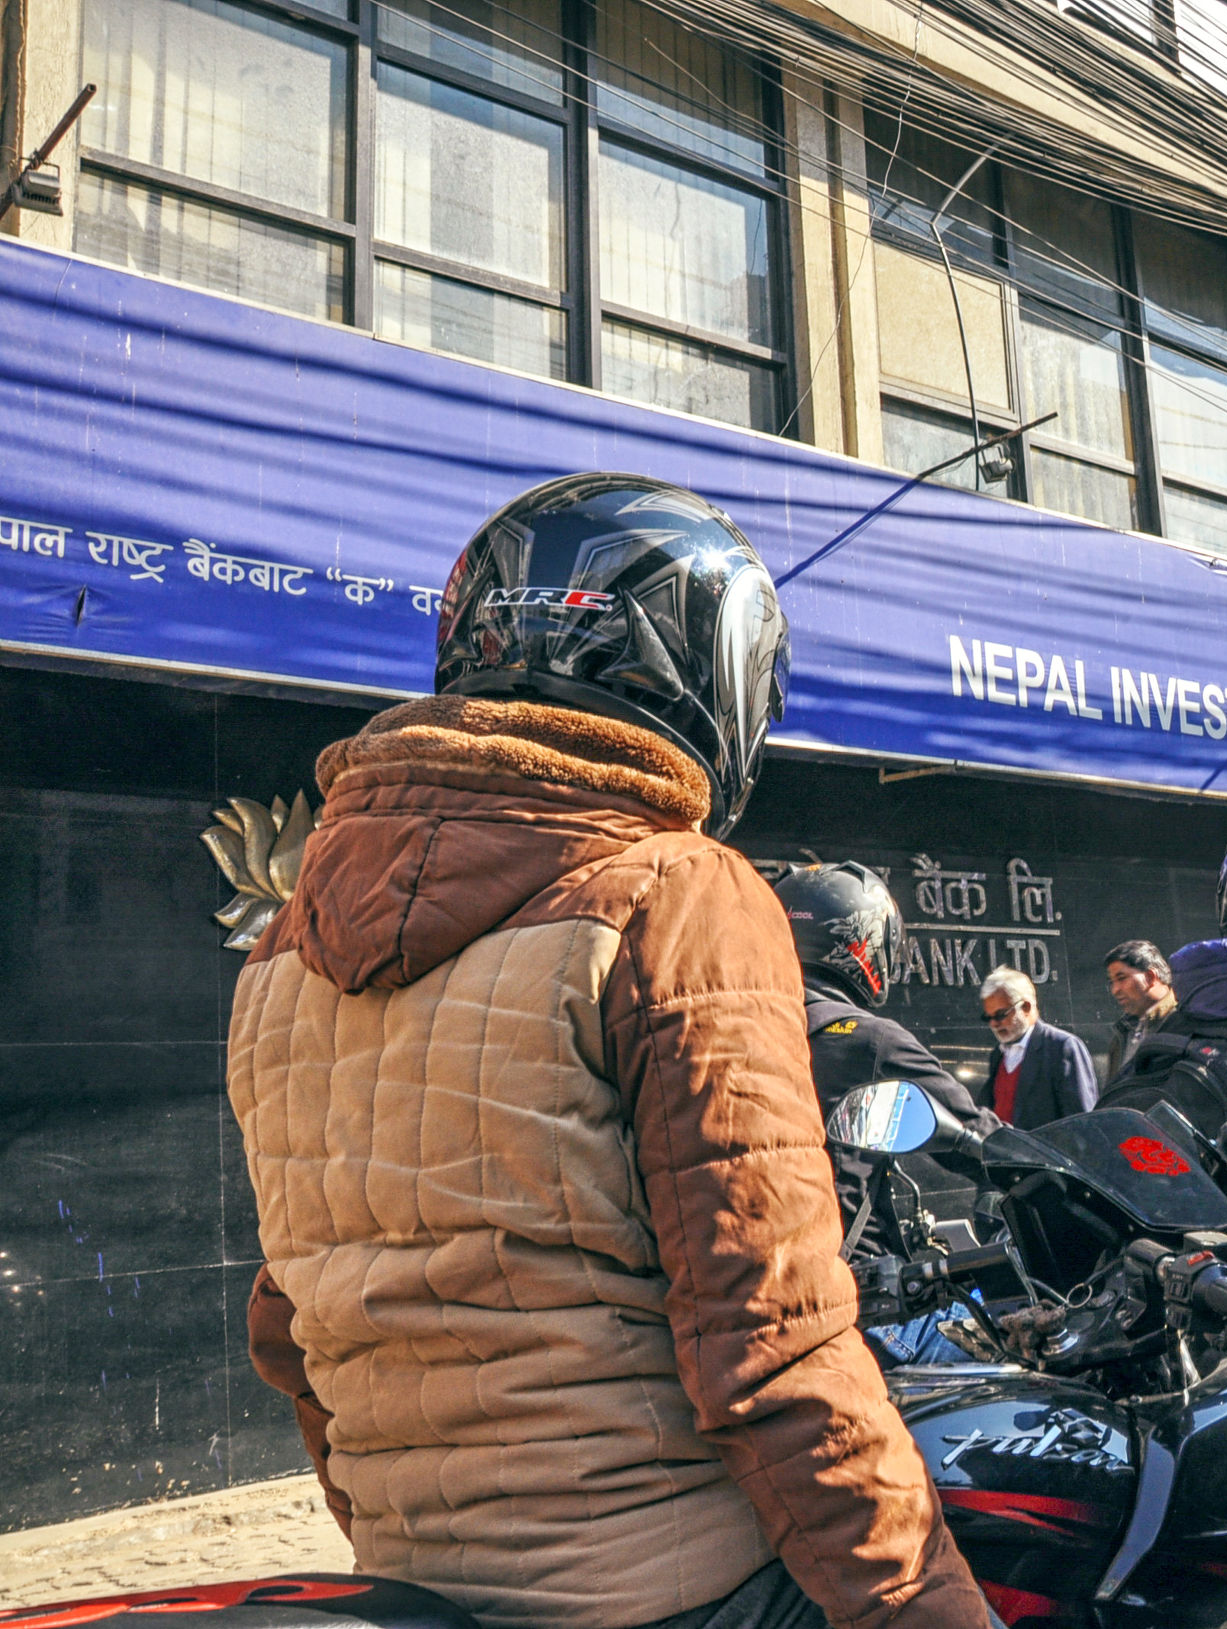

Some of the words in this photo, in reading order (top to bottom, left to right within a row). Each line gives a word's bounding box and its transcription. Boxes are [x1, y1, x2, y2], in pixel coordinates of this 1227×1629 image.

[85, 531, 174, 584] राष्ट्र
[182, 538, 314, 595] बैंकबाट
[949, 634, 1103, 721] NEPAL
[909, 853, 986, 920] बैंक
[1007, 857, 1062, 923] लि.
